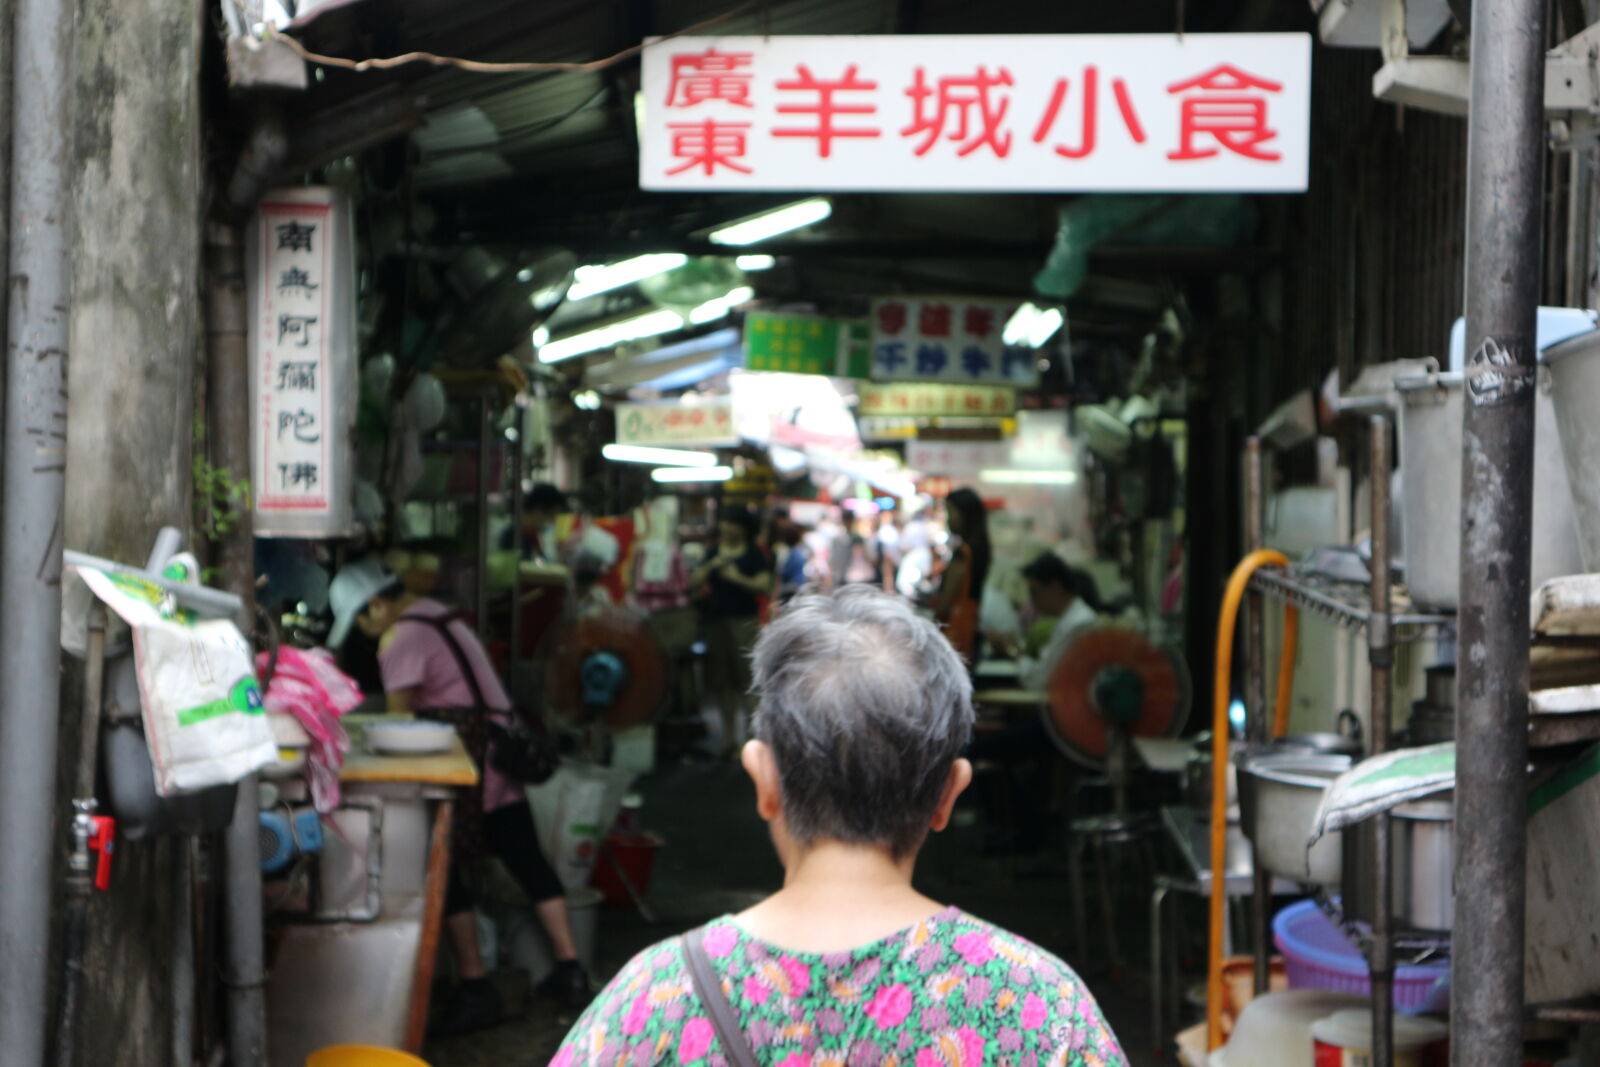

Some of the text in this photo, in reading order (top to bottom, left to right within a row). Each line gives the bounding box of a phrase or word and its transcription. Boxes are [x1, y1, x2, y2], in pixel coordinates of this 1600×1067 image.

[664, 48, 755, 176] 廣東
[771, 65, 1282, 162] 羊城小食
[276, 221, 319, 490] 南無阿彌陀佛
